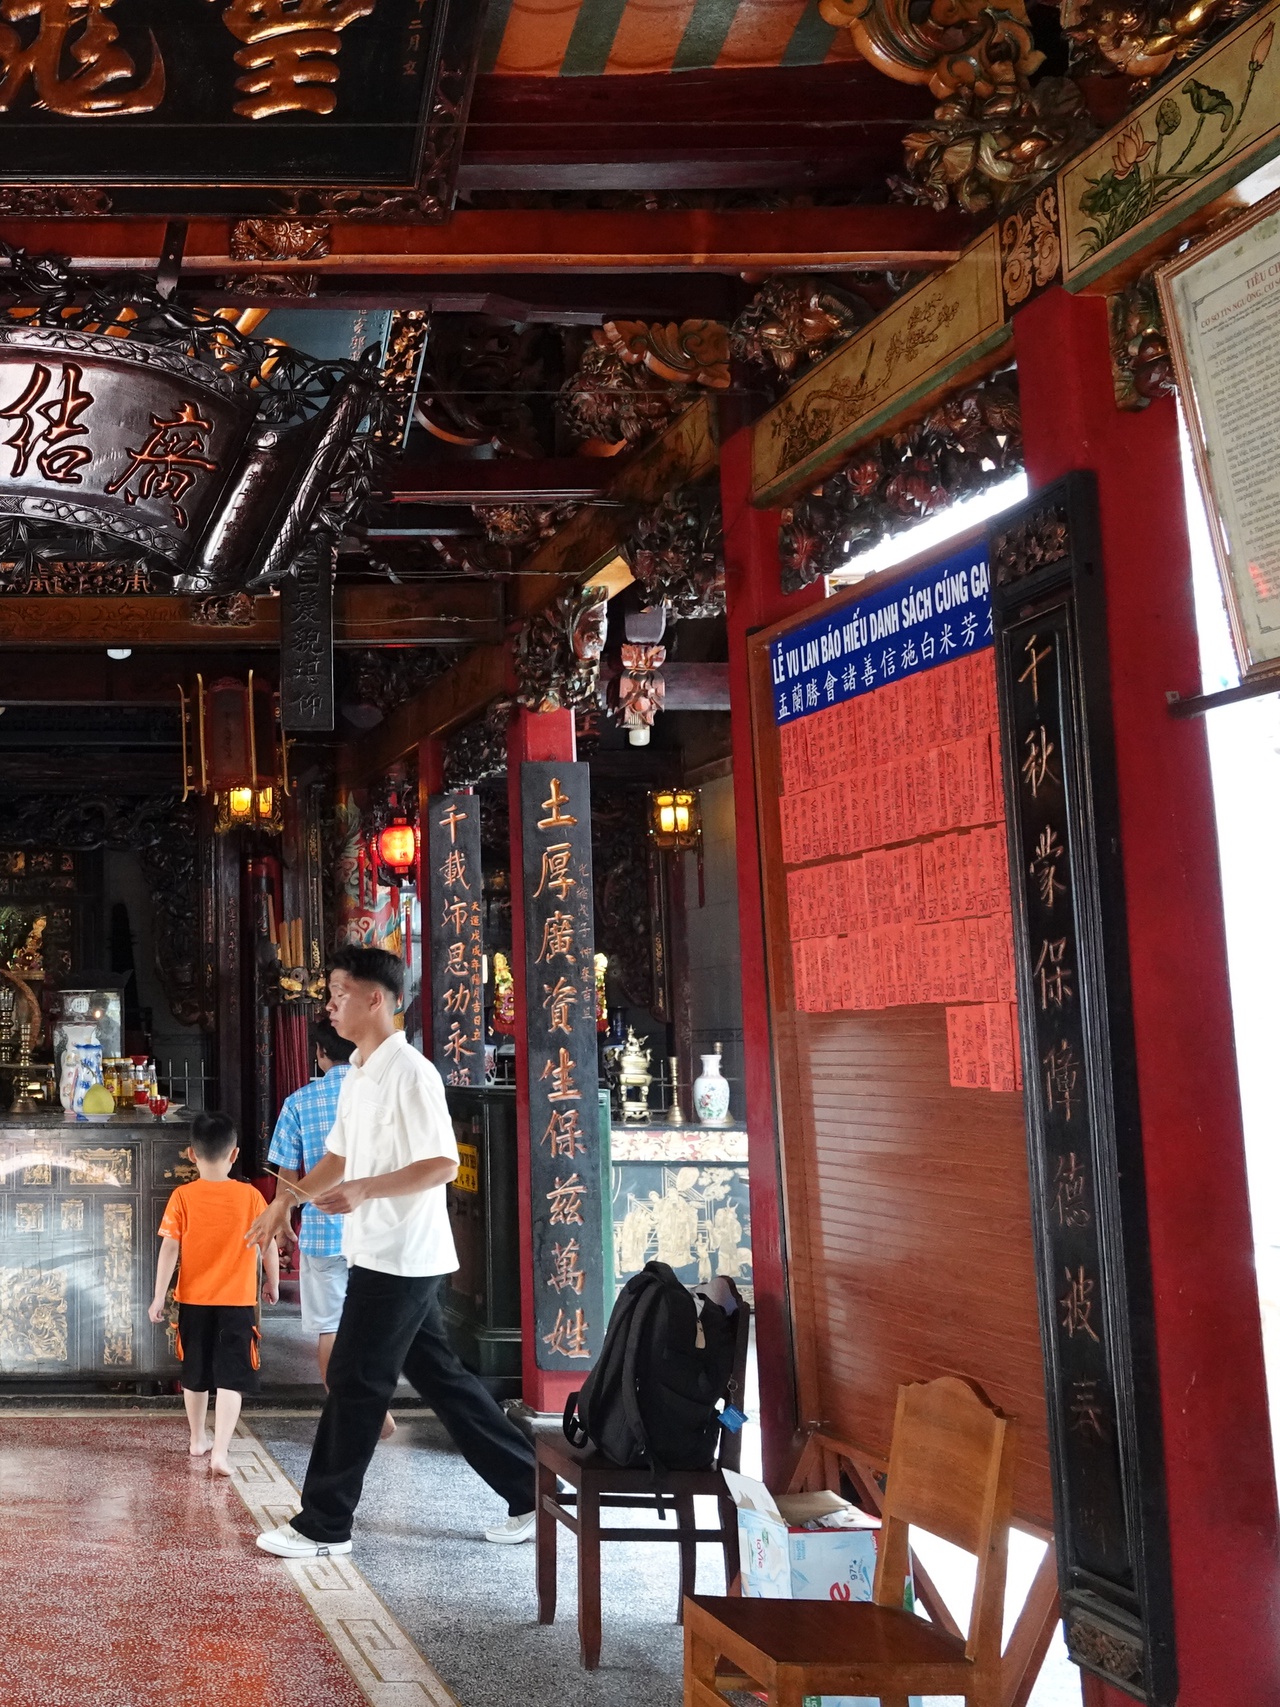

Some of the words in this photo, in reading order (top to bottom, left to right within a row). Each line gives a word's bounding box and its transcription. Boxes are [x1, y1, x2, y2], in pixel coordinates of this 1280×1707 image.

[773, 642, 785, 685] LỄ
[786, 649, 800, 680] VU
[801, 639, 820, 673] LAN
[820, 622, 841, 663] BÁO
[843, 607, 868, 655] HIẾU
[869, 602, 900, 643] DANH
[901, 586, 933, 628] SÁCH
[934, 569, 969, 614] CÚNG
